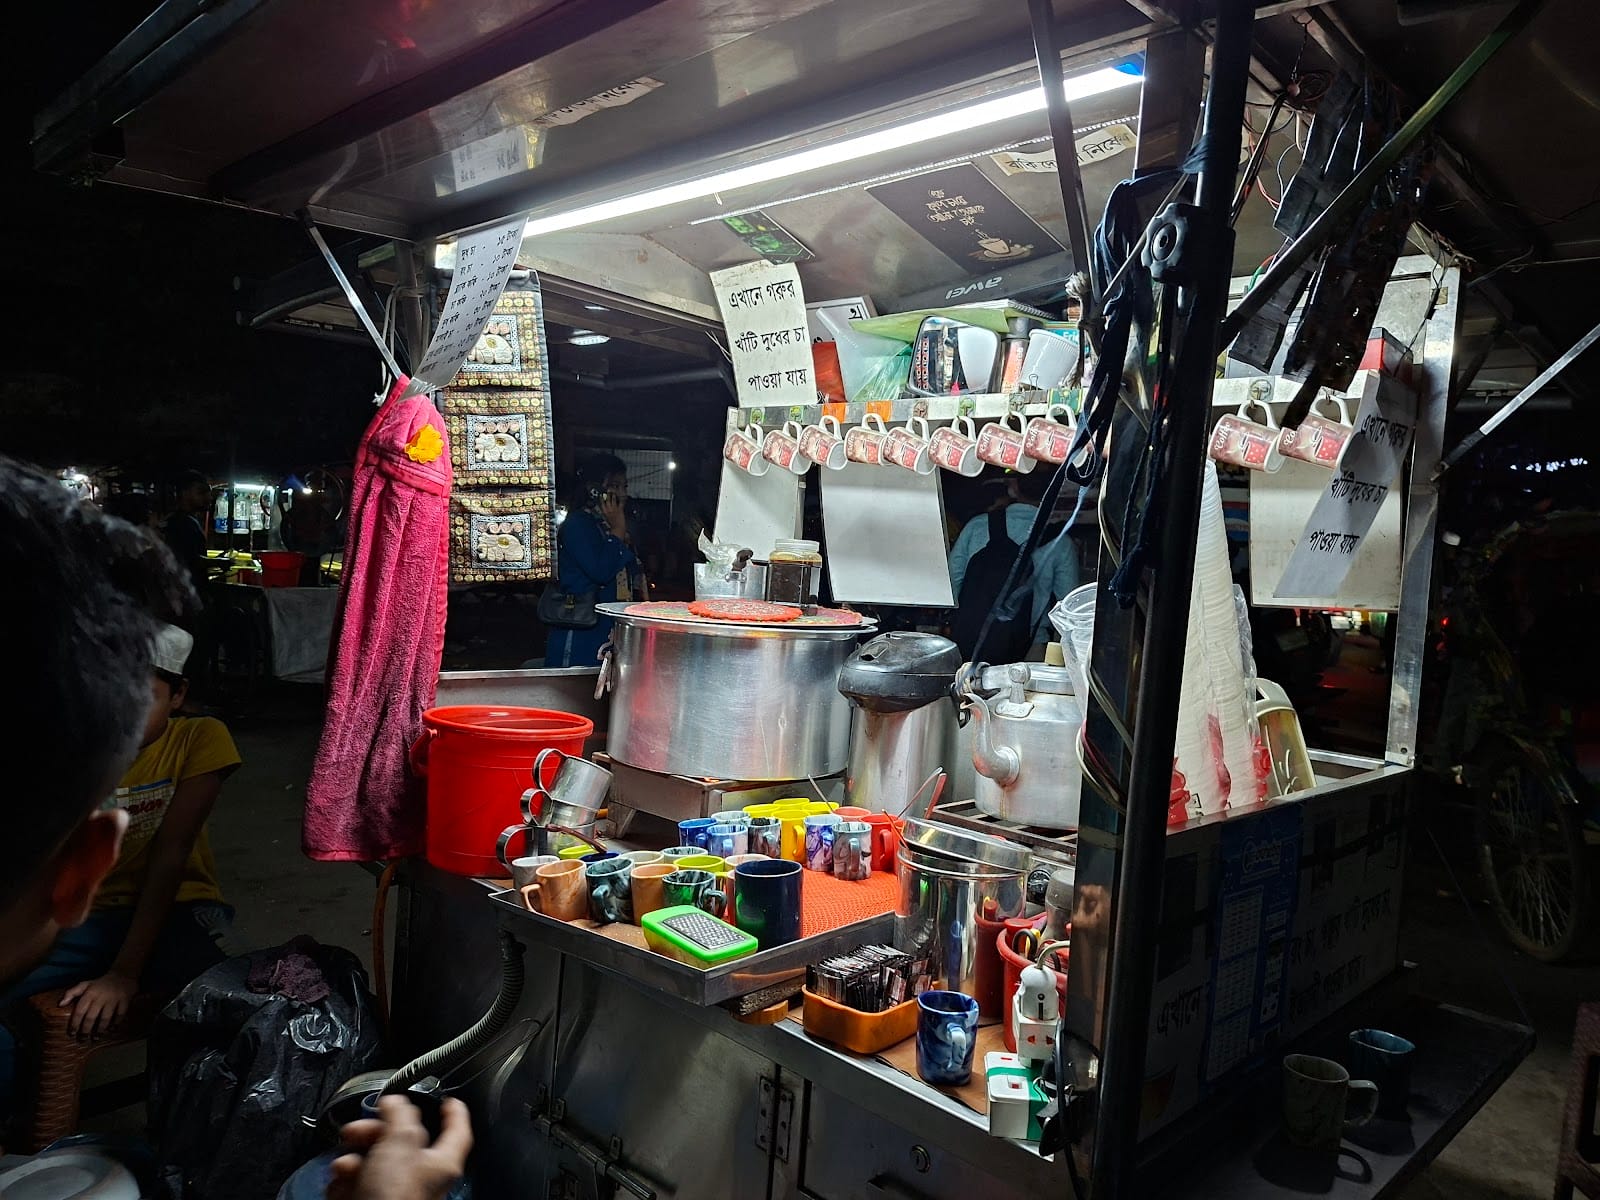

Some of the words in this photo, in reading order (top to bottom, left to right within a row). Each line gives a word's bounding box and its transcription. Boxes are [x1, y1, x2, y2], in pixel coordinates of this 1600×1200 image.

[728, 286, 764, 310] এখানে
[766, 280, 796, 303] গরুর
[735, 330, 758, 353] খাঁটি
[760, 330, 791, 352] দুধের
[793, 327, 805, 343] চা
[748, 372, 783, 391] পাওয়া
[786, 368, 807, 386] যায়
[1361, 414, 1389, 443] এখানে
[1310, 529, 1341, 553] পাওয়া
[1340, 532, 1361, 554] যায়
